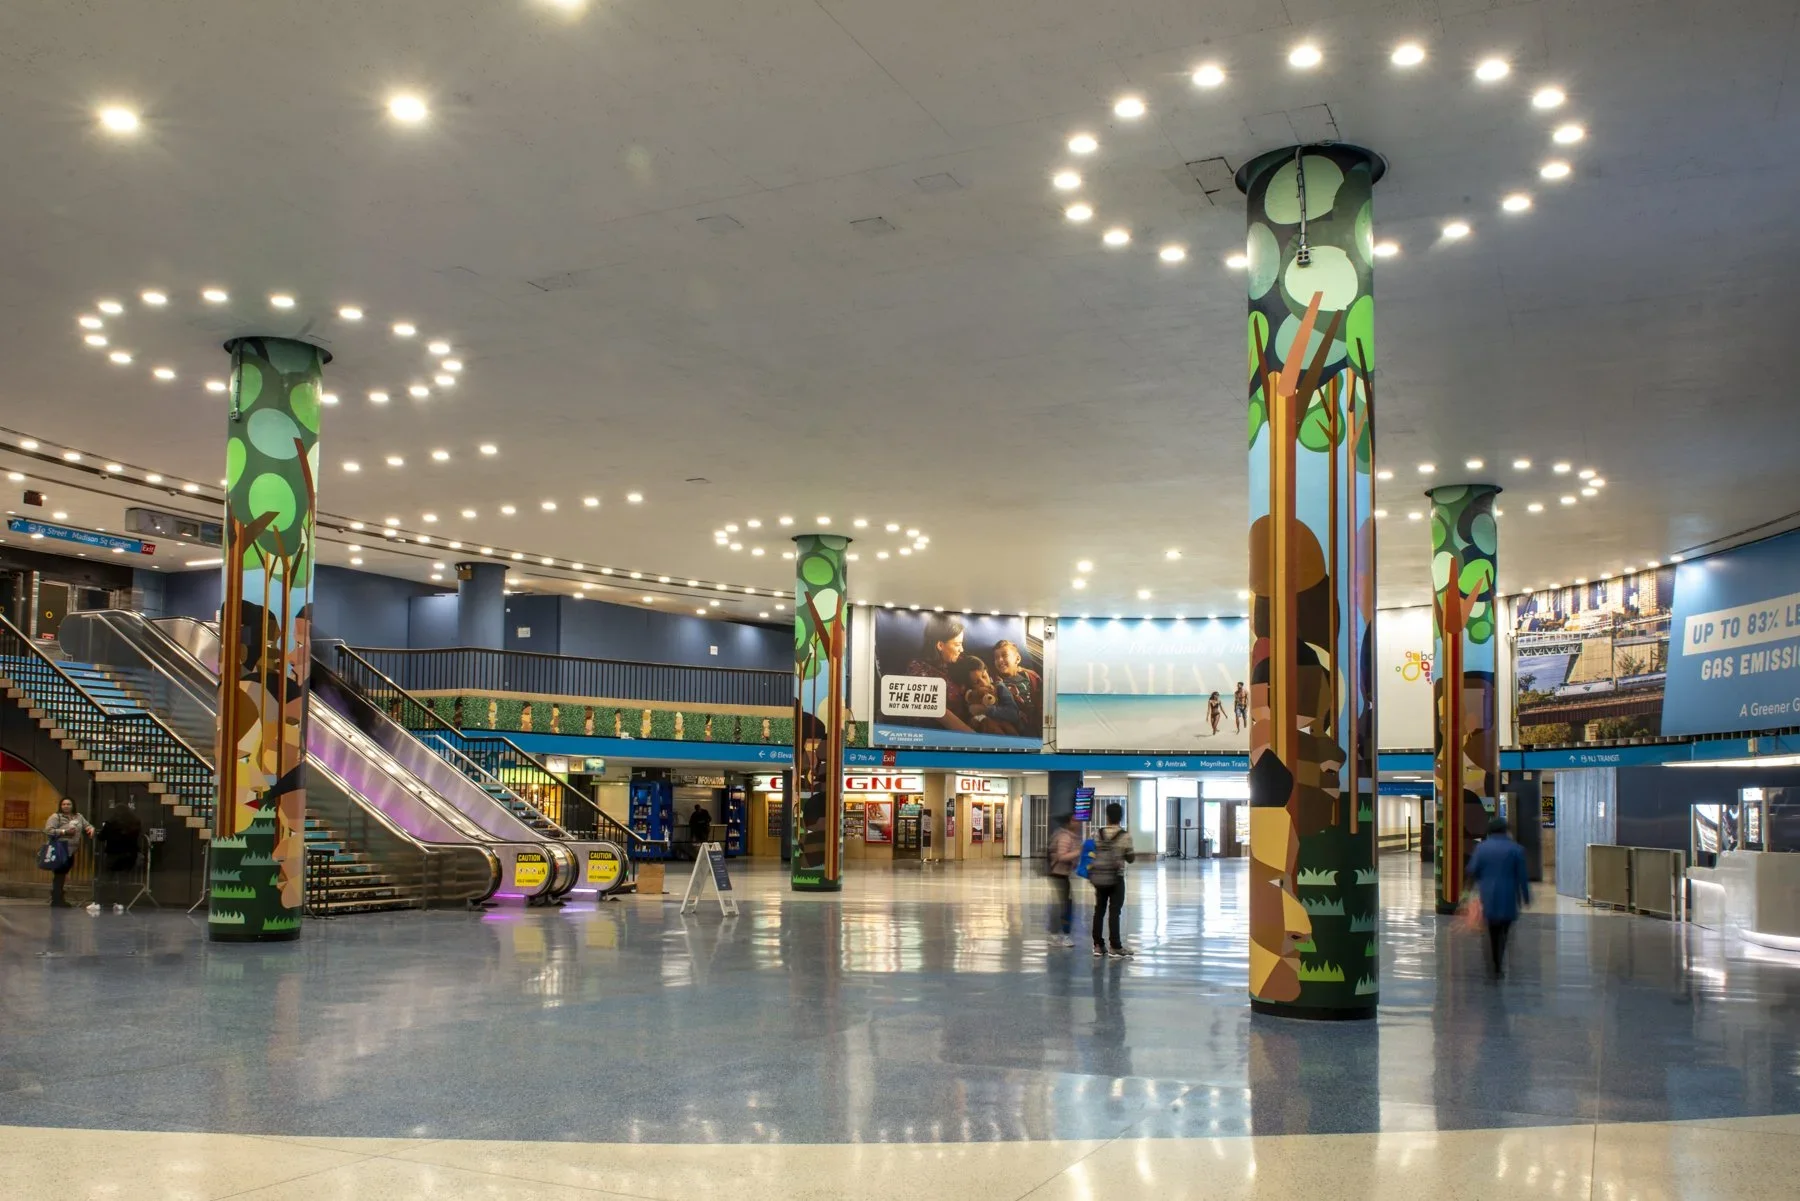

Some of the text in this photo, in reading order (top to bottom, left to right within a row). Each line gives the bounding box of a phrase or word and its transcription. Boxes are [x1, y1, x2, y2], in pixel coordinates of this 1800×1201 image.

[37, 526, 154, 553] To Street Madison Sq Garden Exit
[1692, 622, 1714, 645] UP
[1720, 617, 1740, 640] TO
[1747, 608, 1779, 636] 83%
[1701, 656, 1734, 680] GAS
[888, 682, 938, 692] GET LOST IN
[888, 691, 939, 703] THE RIDE
[1739, 703, 1748, 717] A
[1751, 701, 1790, 717] Greener
[857, 753, 867, 761] 7th
[883, 754, 896, 763] Exit
[1200, 760, 1230, 768] Moynihan
[1588, 754, 1620, 763] NJ TRANSIT
[845, 776, 917, 790] GNC
[960, 778, 991, 792] GNC
[517, 854, 541, 862] CAUTION
[589, 851, 612, 860] CAUTION
